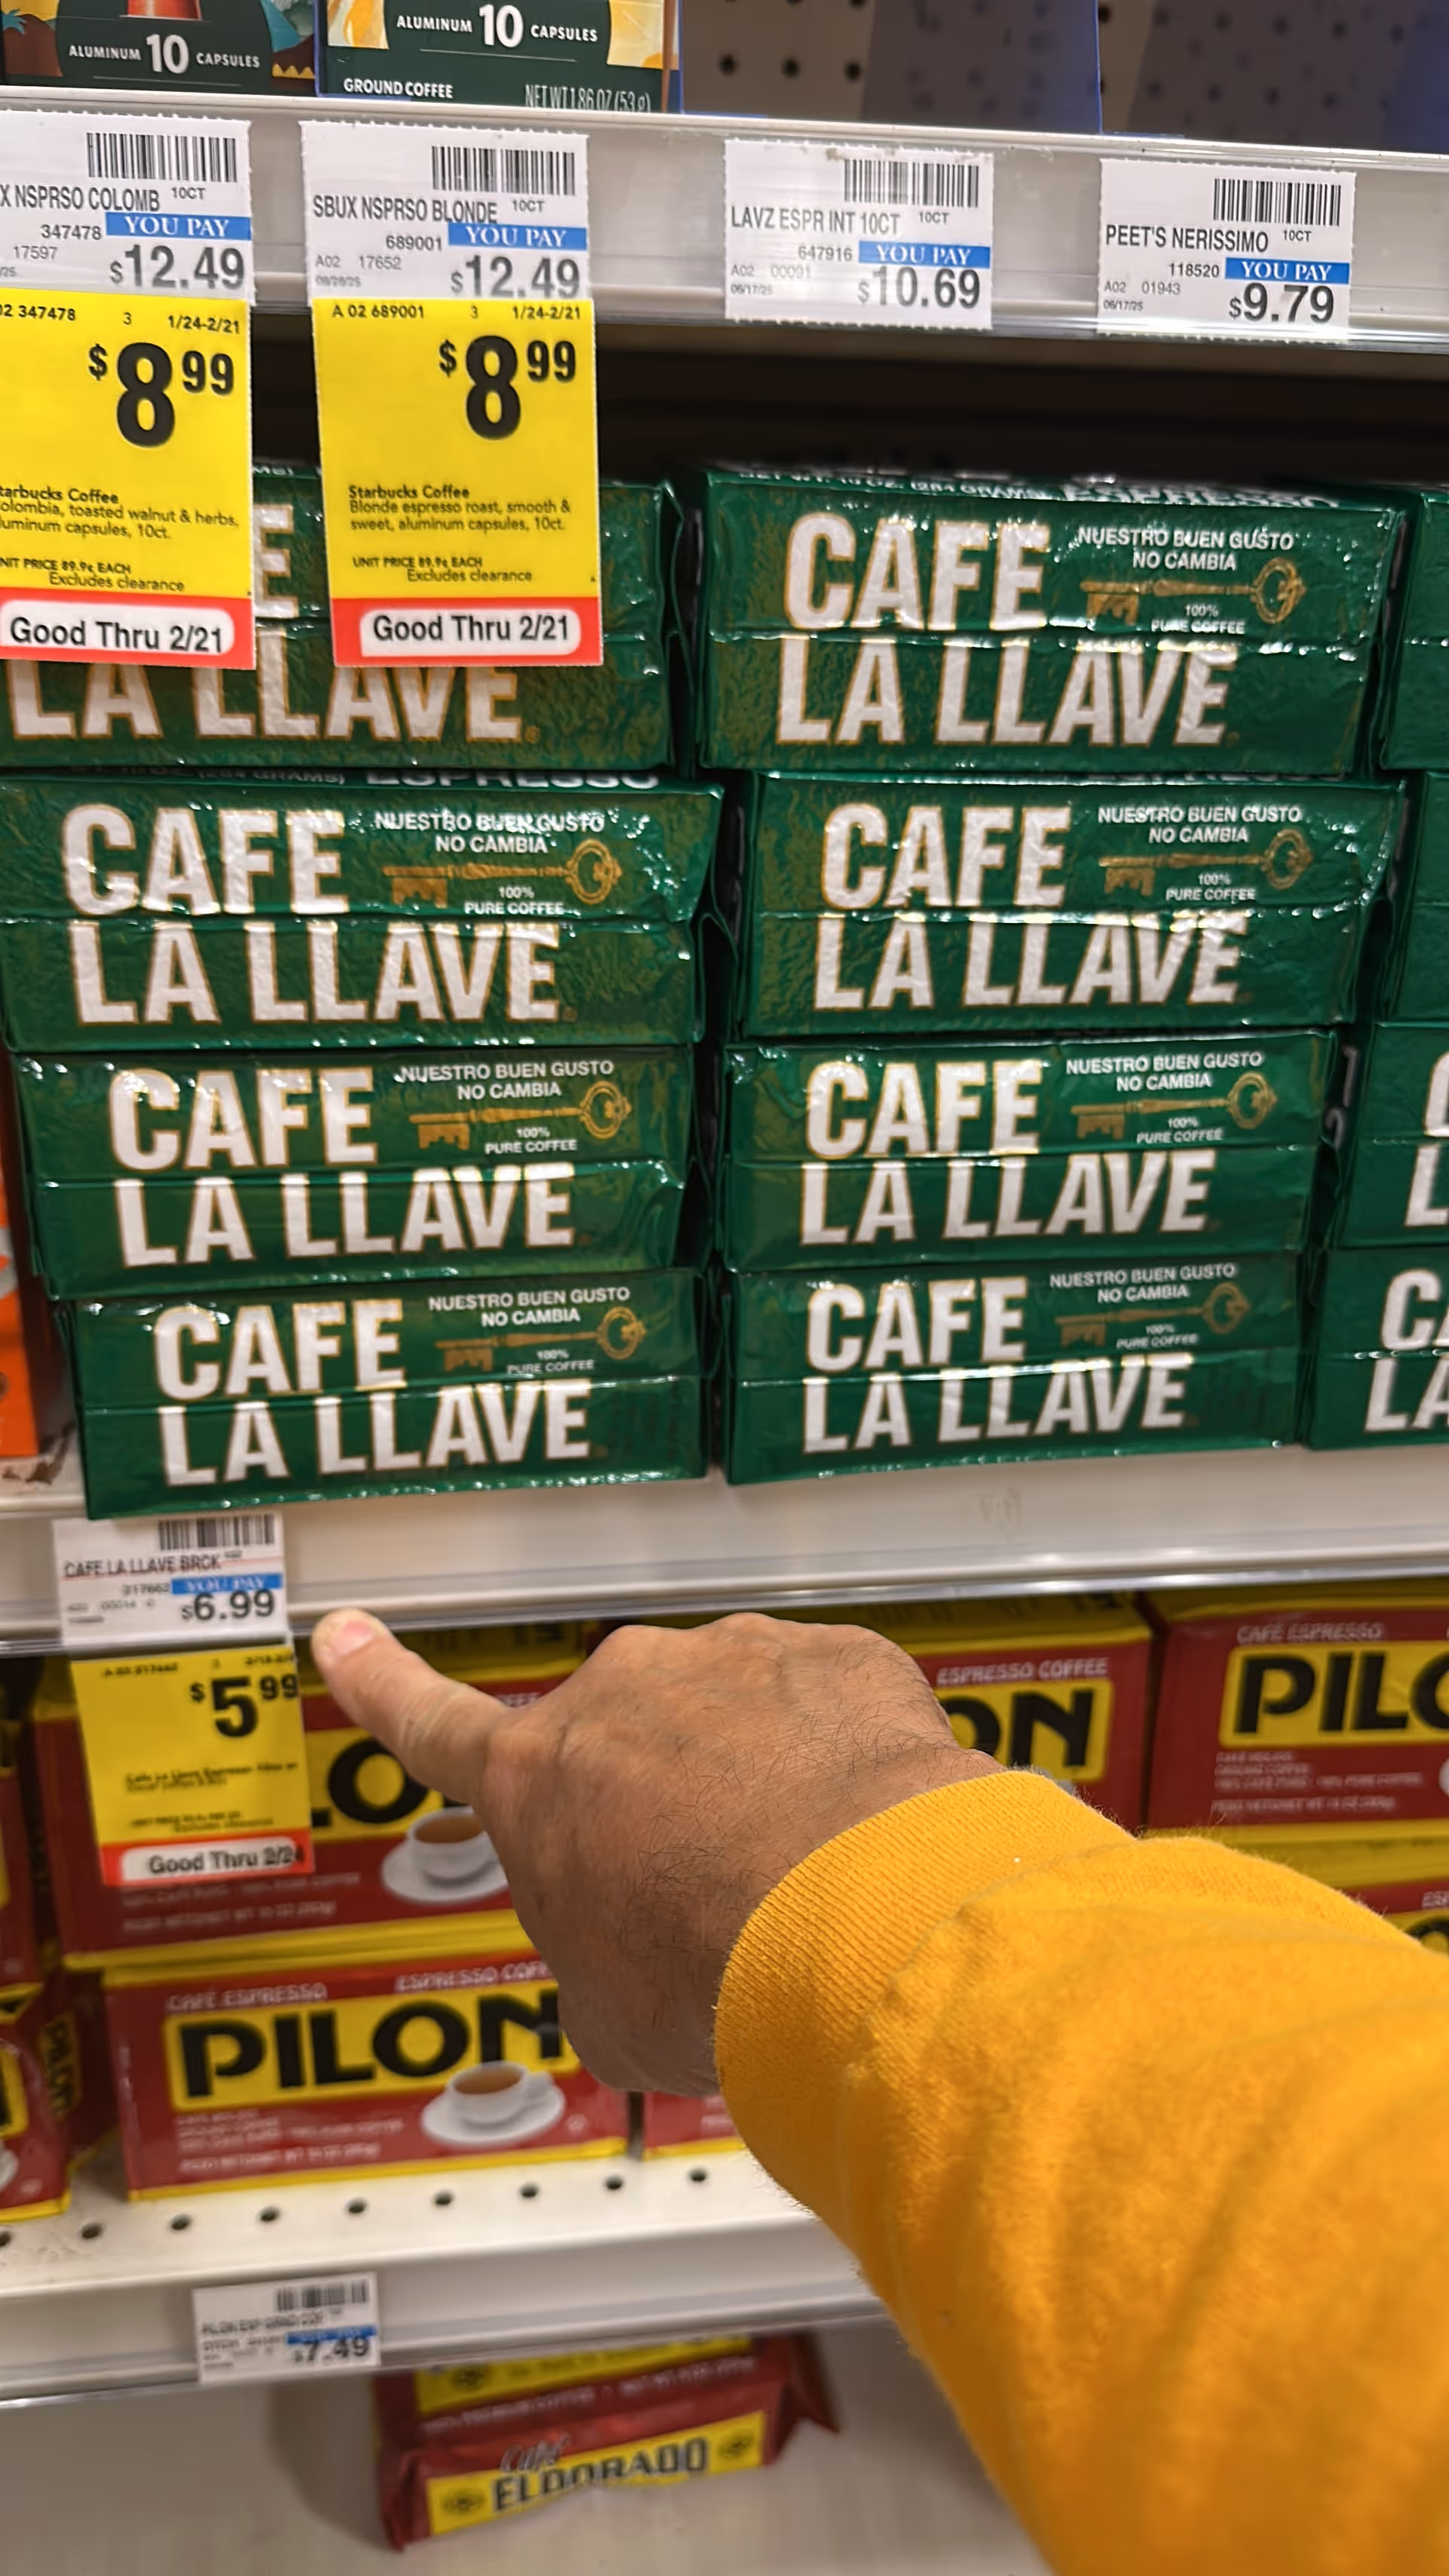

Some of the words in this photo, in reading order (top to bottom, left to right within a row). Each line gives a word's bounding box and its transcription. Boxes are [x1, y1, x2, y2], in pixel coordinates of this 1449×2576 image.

[397, 15, 472, 32] ALUMINUM
[479, 4, 524, 48] 10
[531, 25, 598, 42] CAPSULES
[69, 45, 141, 60] ALUMINUM
[146, 34, 189, 74] 10
[196, 53, 260, 68] CAPSULES
[343, 78, 401, 96] GROUND
[405, 81, 453, 99] COFFEE
[16, 186, 84, 210] NSPRSO
[88, 188, 160, 212] COLOMB
[171, 187, 206, 199] 10CT
[313, 195, 358, 219] SBUX
[362, 197, 427, 221] NSPRSO
[432, 200, 498, 224] BLONDE
[512, 200, 545, 213] 10CT
[125, 216, 178, 235] YOU
[187, 219, 229, 237] PAY
[731, 206, 774, 227] LAVZ
[780, 208, 823, 232] ESPR
[829, 211, 855, 233] INT
[861, 213, 900, 235] 10CT
[919, 211, 949, 225] 10CT
[41, 224, 101, 240] 347478
[386, 235, 442, 251] 689001
[465, 226, 517, 247] YOU
[526, 229, 567, 248] PAY
[1106, 224, 1166, 248] PEET'S
[1172, 227, 1269, 253] NERISSIMO
[1283, 229, 1312, 243] 10CT
[13, 245, 57, 260] 17597
[798, 245, 853, 262] 647916
[877, 243, 925, 263] YOU
[933, 246, 971, 265] PAY
[109, 244, 245, 291] $12.49
[451, 254, 580, 300] $12.49
[1170, 263, 1220, 279] 118520
[1241, 261, 1287, 279] YOU
[1295, 264, 1332, 282] PAY
[858, 266, 980, 309] $10.69
[1104, 282, 1127, 293] A02
[1141, 282, 1180, 294] 01943
[372, 305, 424, 319] 689001
[512, 306, 580, 320] 1/24-2/21
[1229, 282, 1334, 324] $9.79
[18, 306, 76, 322] 347478
[168, 315, 240, 334] 1/24-2/21
[69, 488, 118, 504] Coffee
[349, 485, 417, 499] Starbucks
[422, 485, 470, 499] Coffee
[69, 504, 125, 520] toasted
[128, 508, 176, 523] walnut
[180, 512, 190, 523] &
[195, 511, 239, 528] herbs,
[350, 500, 398, 513] Blonde
[402, 501, 462, 517] espresso
[466, 502, 503, 515] roast,
[507, 499, 557, 513] smooth
[561, 500, 571, 513] &
[66, 521, 131, 539] capsules,
[350, 518, 394, 532] sweet,
[398, 516, 464, 531] aluminum
[468, 517, 528, 535] capsules,
[23, 559, 57, 571] PRICE
[352, 557, 379, 568] UNIT
[383, 557, 415, 568] PRICE
[451, 557, 482, 568] EACH
[783, 510, 1051, 631] CAFE
[49, 573, 113, 588] Excludes
[117, 577, 185, 592] clearance
[407, 568, 466, 583] Excludes
[470, 568, 532, 582] clearance
[10, 617, 85, 647] Good
[95, 620, 160, 650] Thru
[169, 625, 223, 654] 2/21
[374, 615, 442, 641] Good
[451, 615, 510, 642] Thru
[519, 614, 569, 641] 2/21
[775, 635, 905, 746] LA
[935, 639, 1238, 746] LLAVE
[375, 811, 471, 833] NUESTRO
[476, 811, 532, 833] BUEN
[535, 813, 605, 834] GUSTO
[1098, 805, 1185, 824] NUESTRO
[1189, 806, 1237, 823] BUEN
[1241, 805, 1303, 823] GUSTO
[435, 835, 466, 854] NO
[469, 835, 548, 854] CAMBIA
[1149, 827, 1175, 843] NO
[1179, 826, 1250, 845] CAMBIA
[62, 802, 349, 916] CAFE
[822, 802, 1070, 908] CAFE
[69, 921, 220, 1025] LA
[248, 921, 561, 1024] LLAVE
[814, 913, 934, 1012] LA
[962, 912, 1247, 1007] LLAVE
[400, 1064, 491, 1083] NUESTRO
[496, 1063, 548, 1079] BUEN
[552, 1060, 614, 1077] GUSTO
[1066, 1057, 1152, 1075] NUESTRO
[1156, 1055, 1202, 1071] BUEN
[1204, 1051, 1263, 1068] GUSTO
[457, 1083, 487, 1100] NO
[491, 1081, 561, 1100] CAMBIA
[1116, 1076, 1142, 1092] NO
[1145, 1073, 1212, 1091] CAMBIA
[107, 1066, 378, 1173] CAFE
[804, 1060, 1041, 1159] CAFE
[516, 1126, 550, 1138] 100%
[485, 1142, 522, 1155] PURE
[526, 1140, 577, 1153] COFFEE
[800, 1162, 916, 1246] LA
[943, 1149, 1216, 1241] LLAVE
[114, 1177, 255, 1270] LA
[281, 1162, 576, 1260] LLAVE
[805, 1276, 1027, 1373] CAFE
[154, 1298, 408, 1402] CAFE
[802, 1373, 912, 1455] LA
[938, 1352, 1193, 1444] LLAVE
[158, 1403, 291, 1488] LA
[314, 1379, 592, 1476] LLAVE
[65, 1560, 103, 1578] CAFE
[182, 1589, 275, 1621] $6.99
[1038, 1657, 1109, 1679] COFFEE
[149, 1854, 205, 1875] Good
[210, 1850, 258, 1870] Thru
[180, 1989, 561, 2097] PILON
